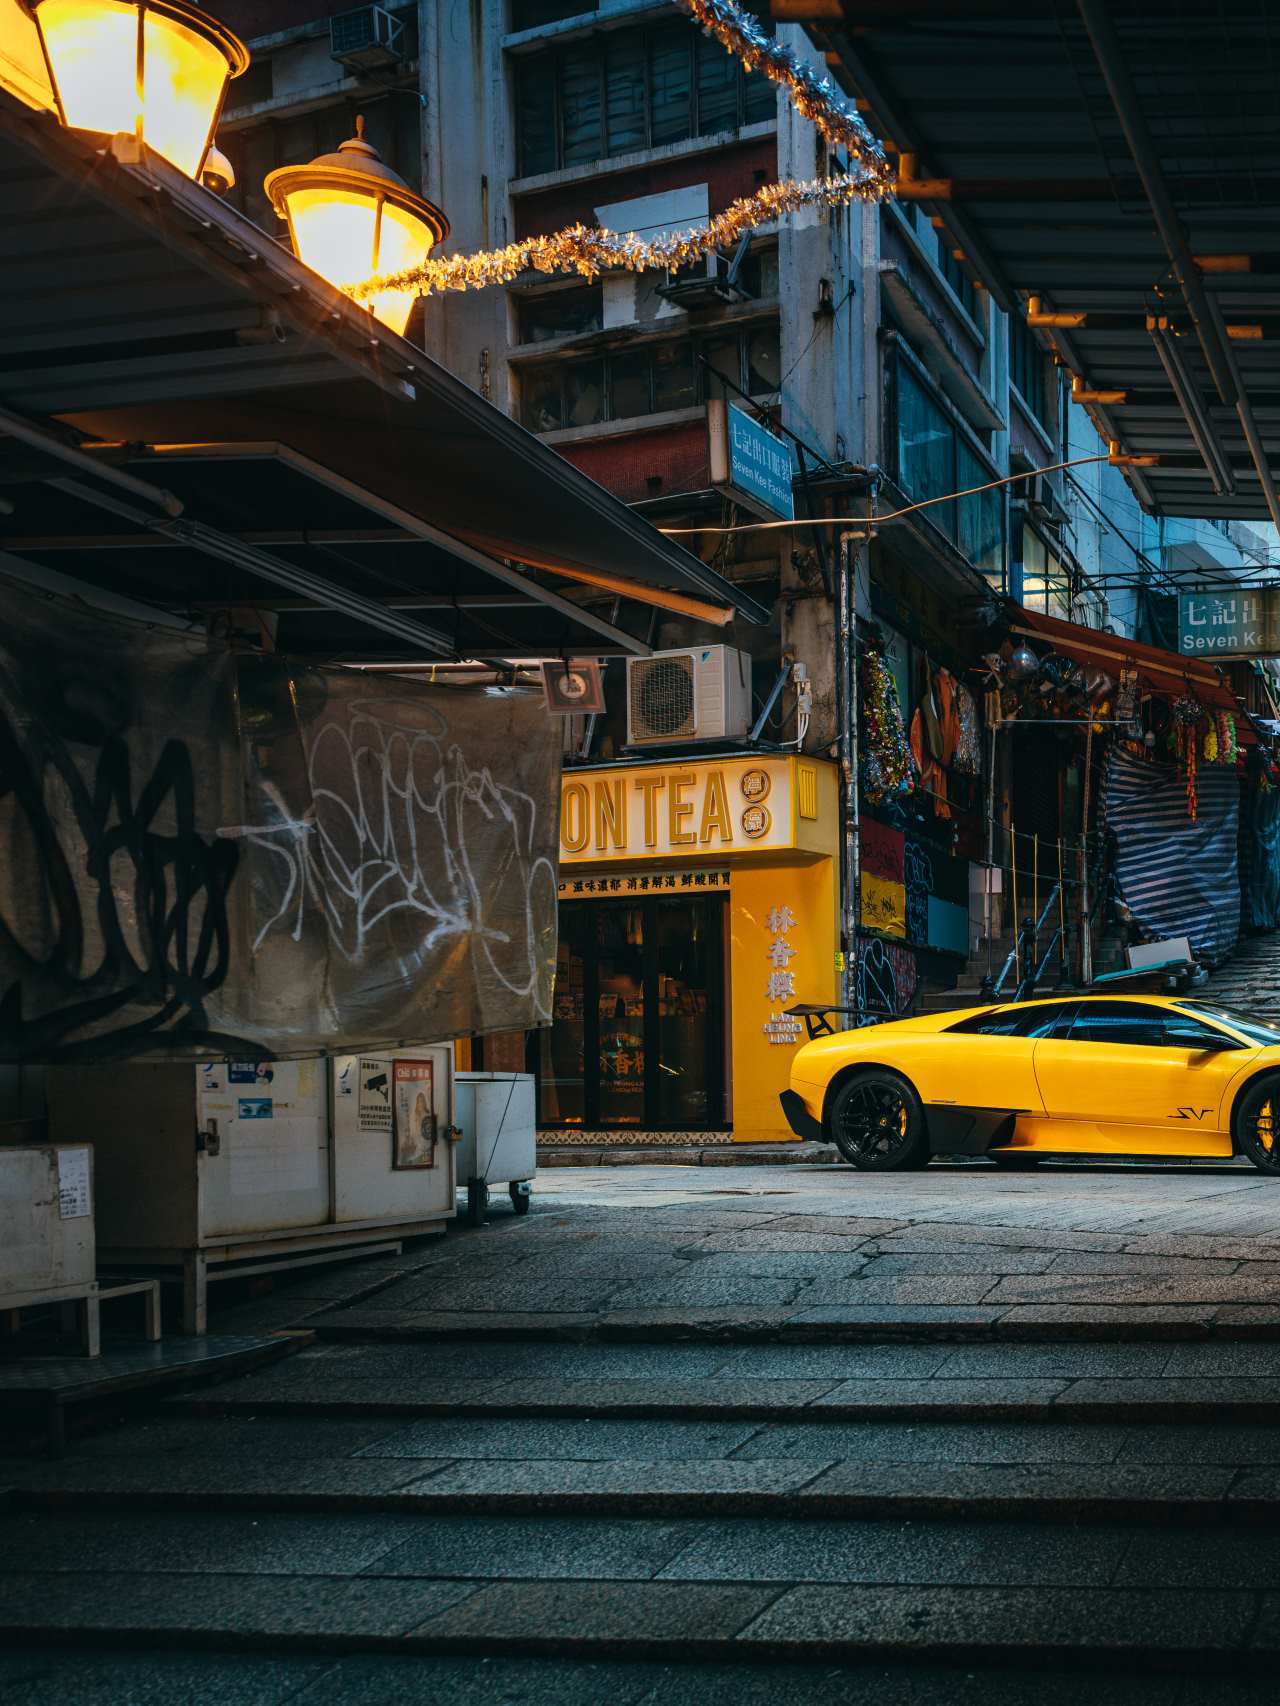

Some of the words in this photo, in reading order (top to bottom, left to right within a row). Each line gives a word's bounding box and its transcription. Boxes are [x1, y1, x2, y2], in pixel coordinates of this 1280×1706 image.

[732, 455, 754, 480] Seven
[754, 469, 767, 489] Kee
[767, 478, 792, 504] Fashion
[1183, 634, 1238, 650] Seven
[1244, 631, 1280, 647] Kee
[633, 769, 734, 847] TEA
